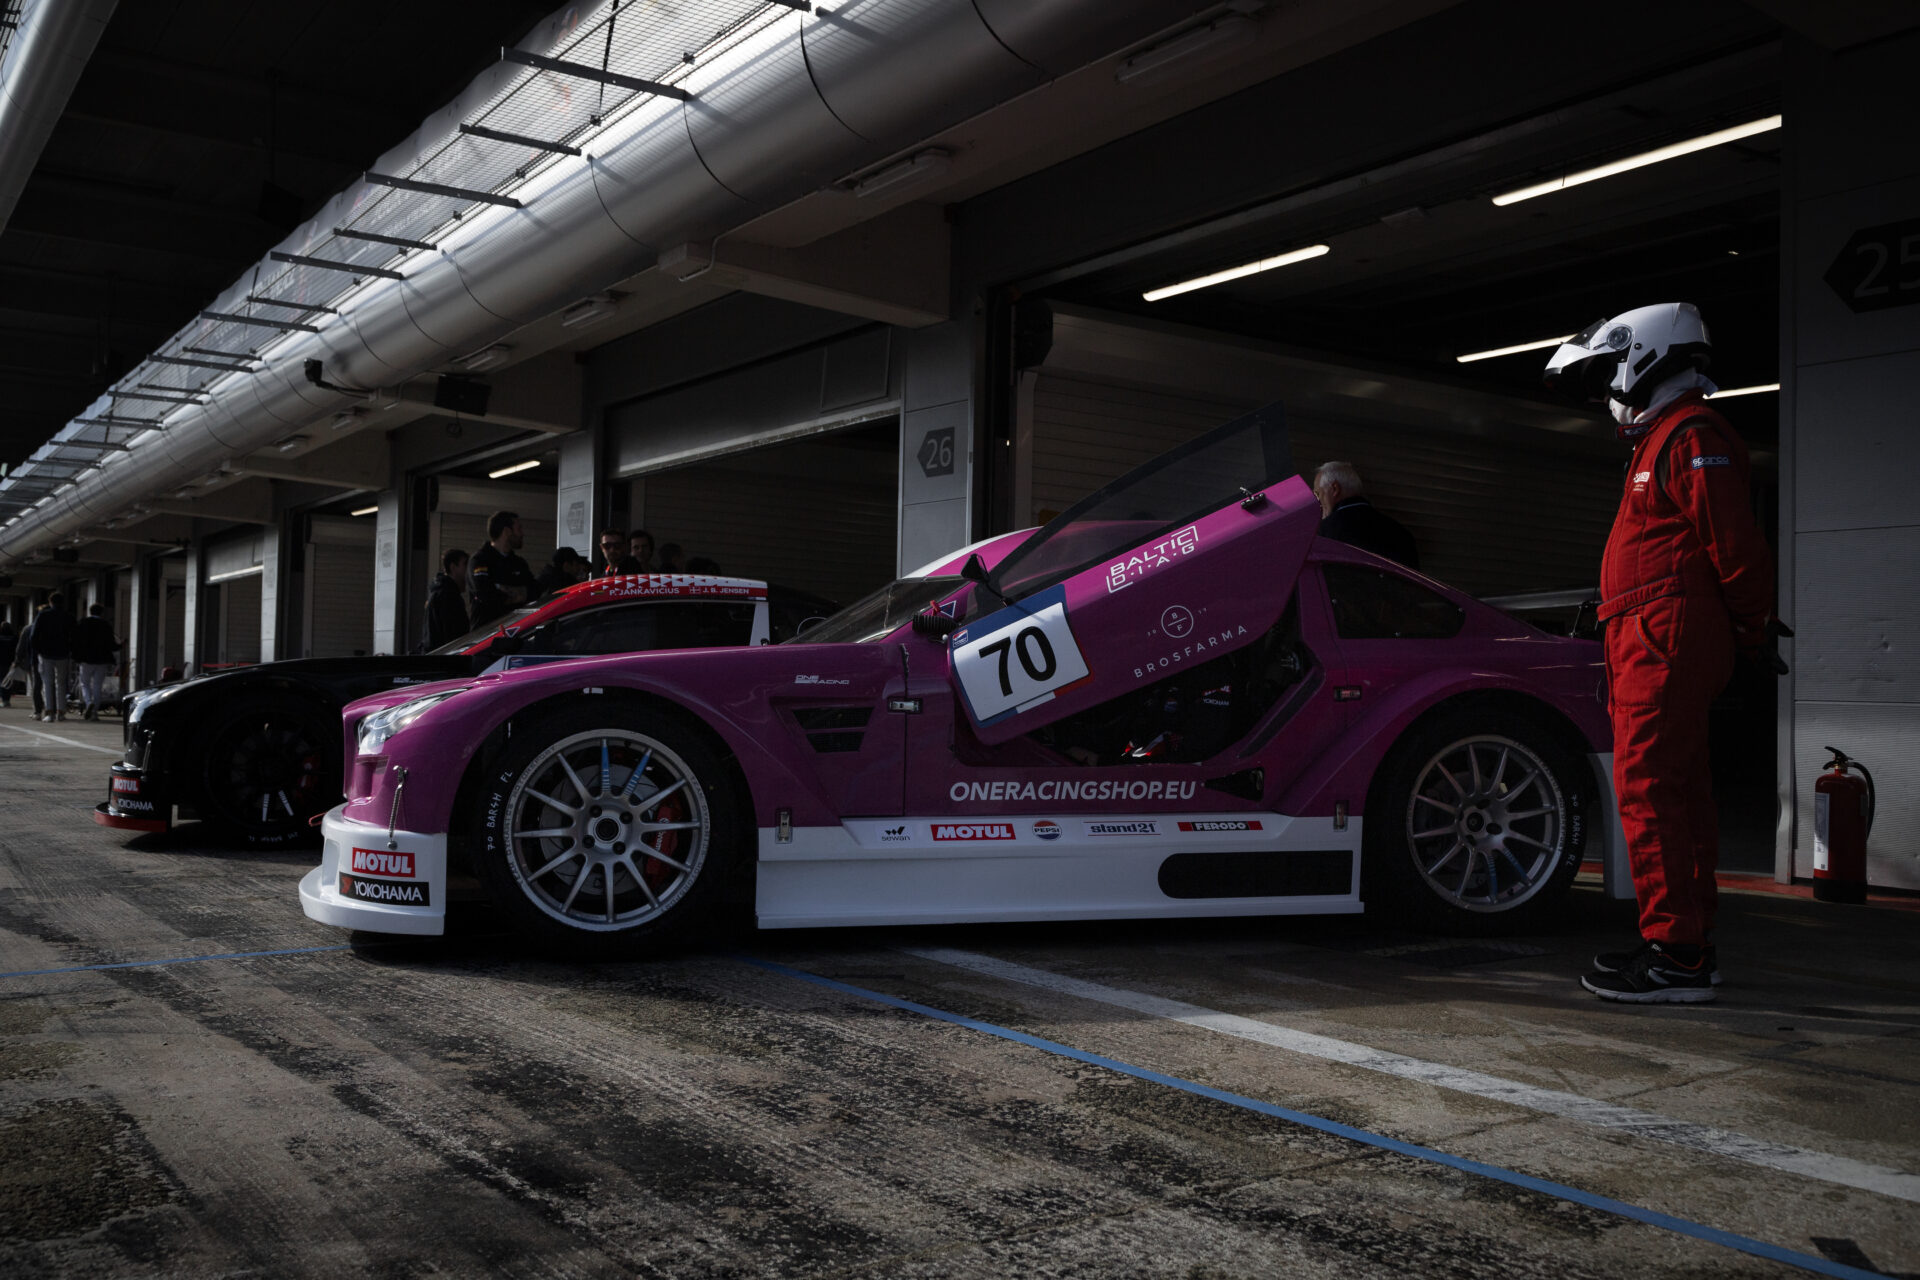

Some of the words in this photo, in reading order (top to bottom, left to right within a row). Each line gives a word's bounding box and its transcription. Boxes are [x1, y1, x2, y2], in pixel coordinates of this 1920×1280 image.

[925, 435, 952, 469] 26
[1110, 531, 1193, 577] BALTIC
[979, 626, 1057, 697] 70
[1133, 624, 1248, 678] BROSFARMA
[114, 777, 139, 792] MOTUL
[950, 780, 1196, 801] ONERACINGSHOP.EU
[936, 825, 1012, 840] MOTUL
[1195, 822, 1247, 831] FERODO
[354, 850, 412, 875] MOTUL
[353, 880, 424, 902] YOKOHAMA
